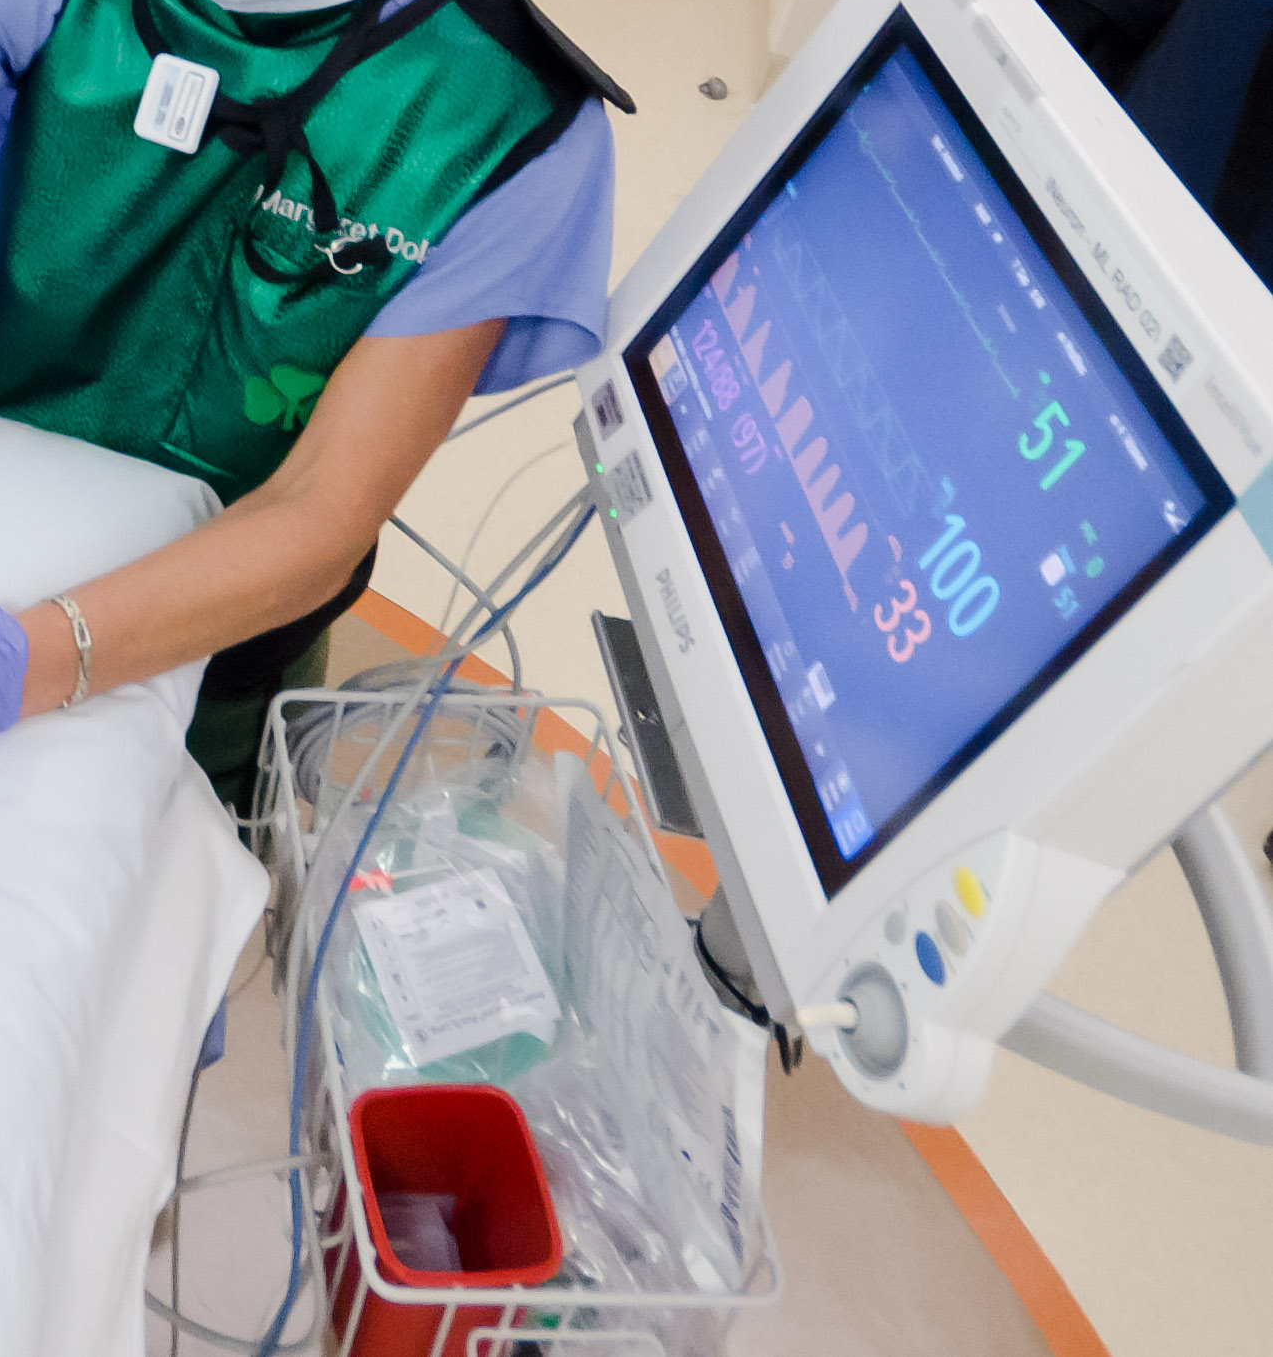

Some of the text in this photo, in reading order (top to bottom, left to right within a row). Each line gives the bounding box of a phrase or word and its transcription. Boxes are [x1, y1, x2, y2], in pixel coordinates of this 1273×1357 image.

[253, 183, 379, 241] Marret
[1111, 267, 1142, 312] RAD
[1017, 400, 1087, 491] 51
[655, 567, 695, 653] PHILIPS
[917, 512, 1001, 637] 100
[873, 578, 932, 663] 33
